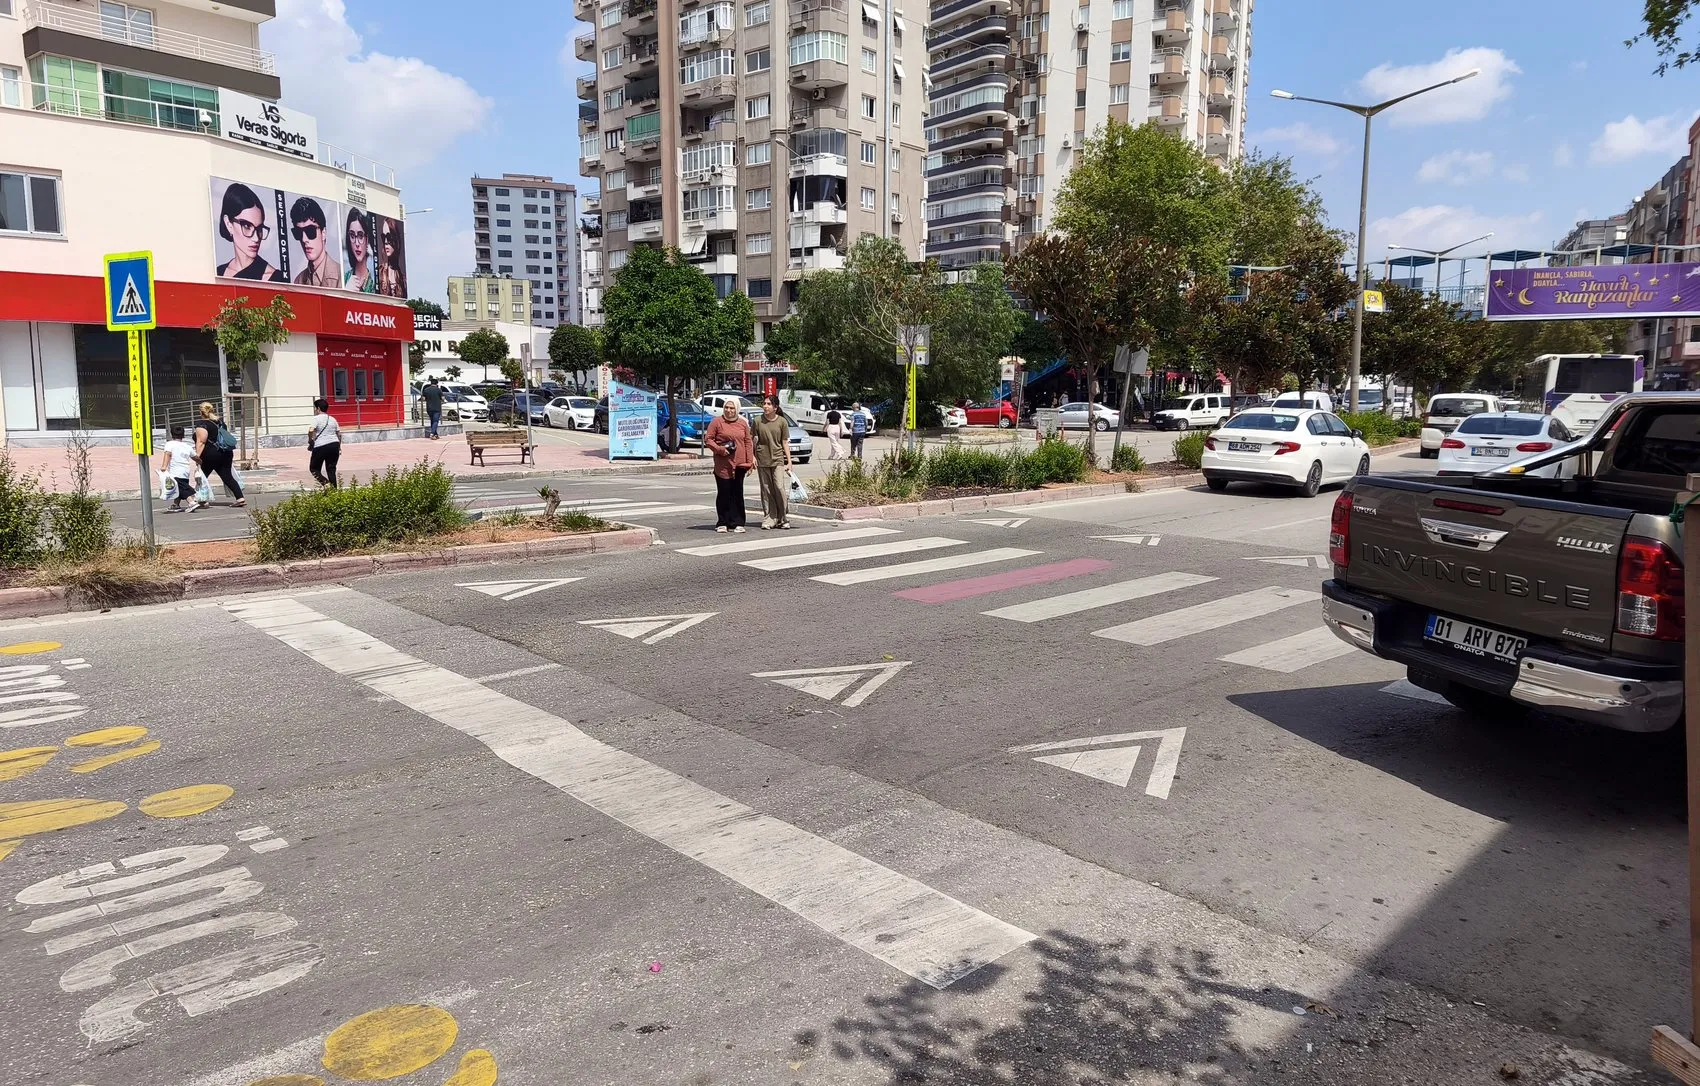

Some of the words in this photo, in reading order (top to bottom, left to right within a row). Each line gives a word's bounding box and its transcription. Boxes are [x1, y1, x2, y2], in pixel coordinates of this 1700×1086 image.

[235, 114, 269, 136] Veras
[270, 124, 307, 147] Sigorta
[1580, 276, 1629, 293] Hayırlı
[1554, 284, 1658, 309] Ramazanlar
[345, 310, 397, 329] AKBANK
[1352, 505, 1377, 516] TOYOTA
[1556, 536, 1615, 555] HILUX
[1362, 542, 1591, 611] INVINCIBLE
[1434, 618, 1453, 639] 01
[1462, 626, 1493, 650] ARV
[1494, 634, 1526, 658] 878
[1453, 643, 1485, 657] ONATÇA
